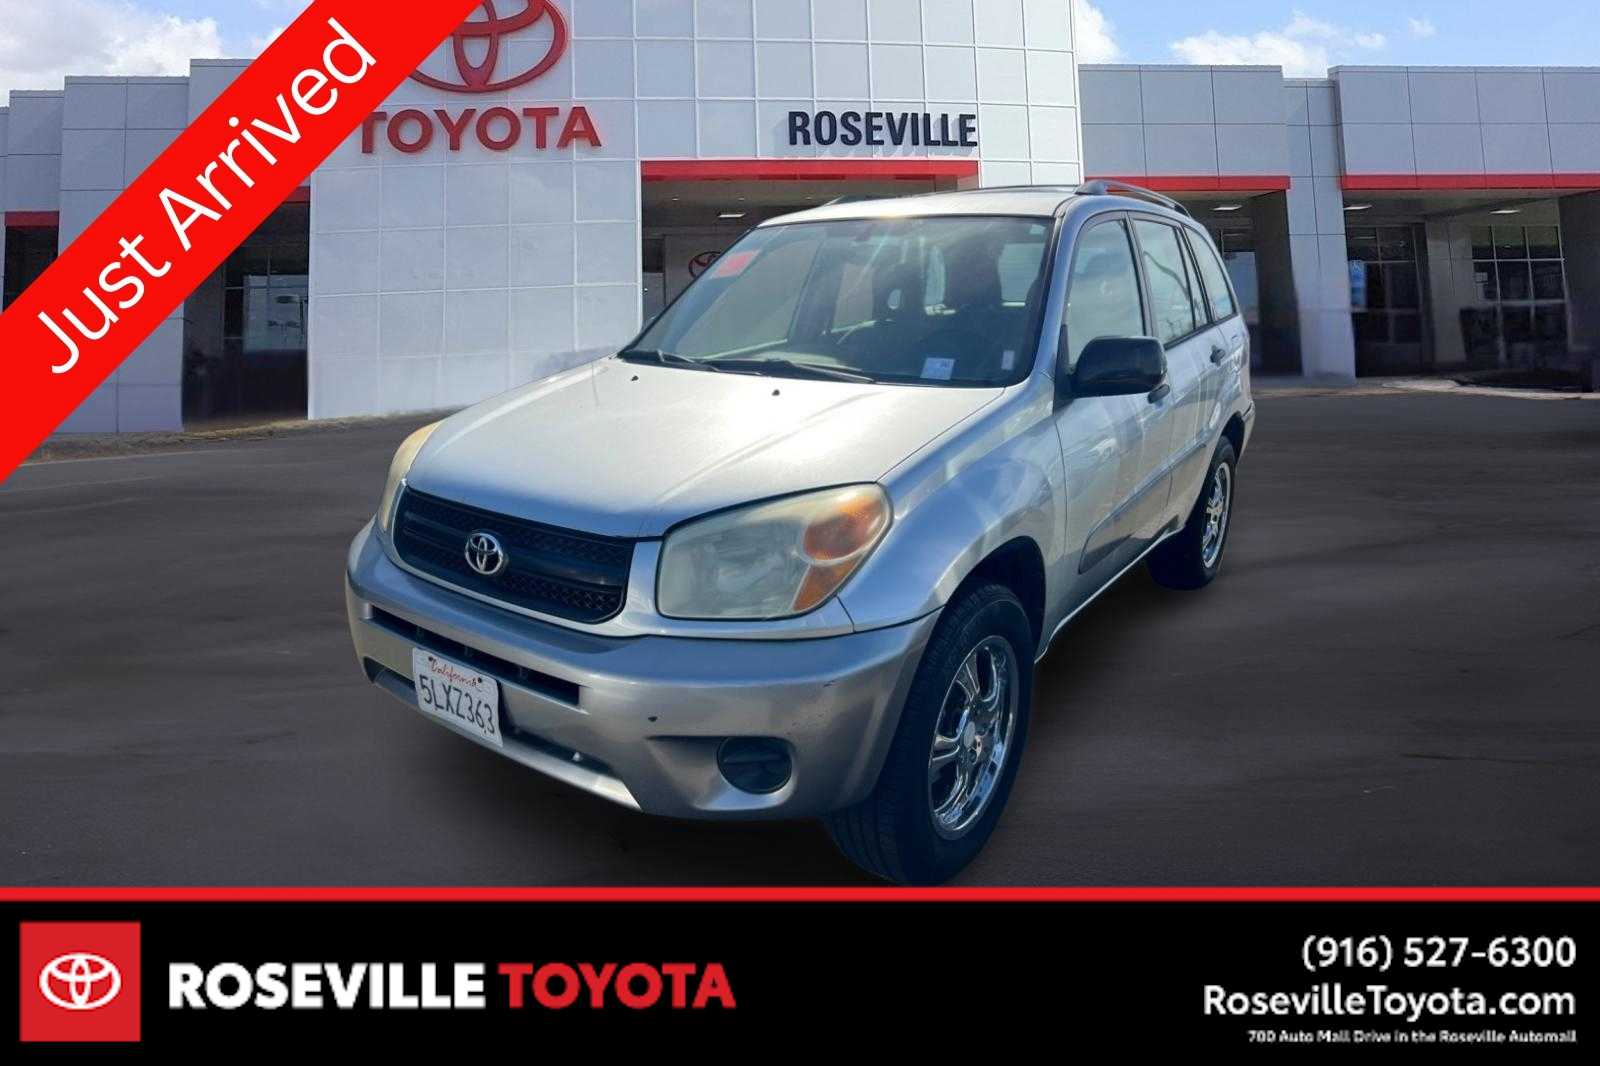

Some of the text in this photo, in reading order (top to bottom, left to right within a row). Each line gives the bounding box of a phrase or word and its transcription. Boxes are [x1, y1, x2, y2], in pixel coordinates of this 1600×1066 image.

[361, 106, 602, 154] TOYOTA
[788, 110, 978, 147] ROSEVILLE
[419, 674, 495, 734] 5LXZ363
